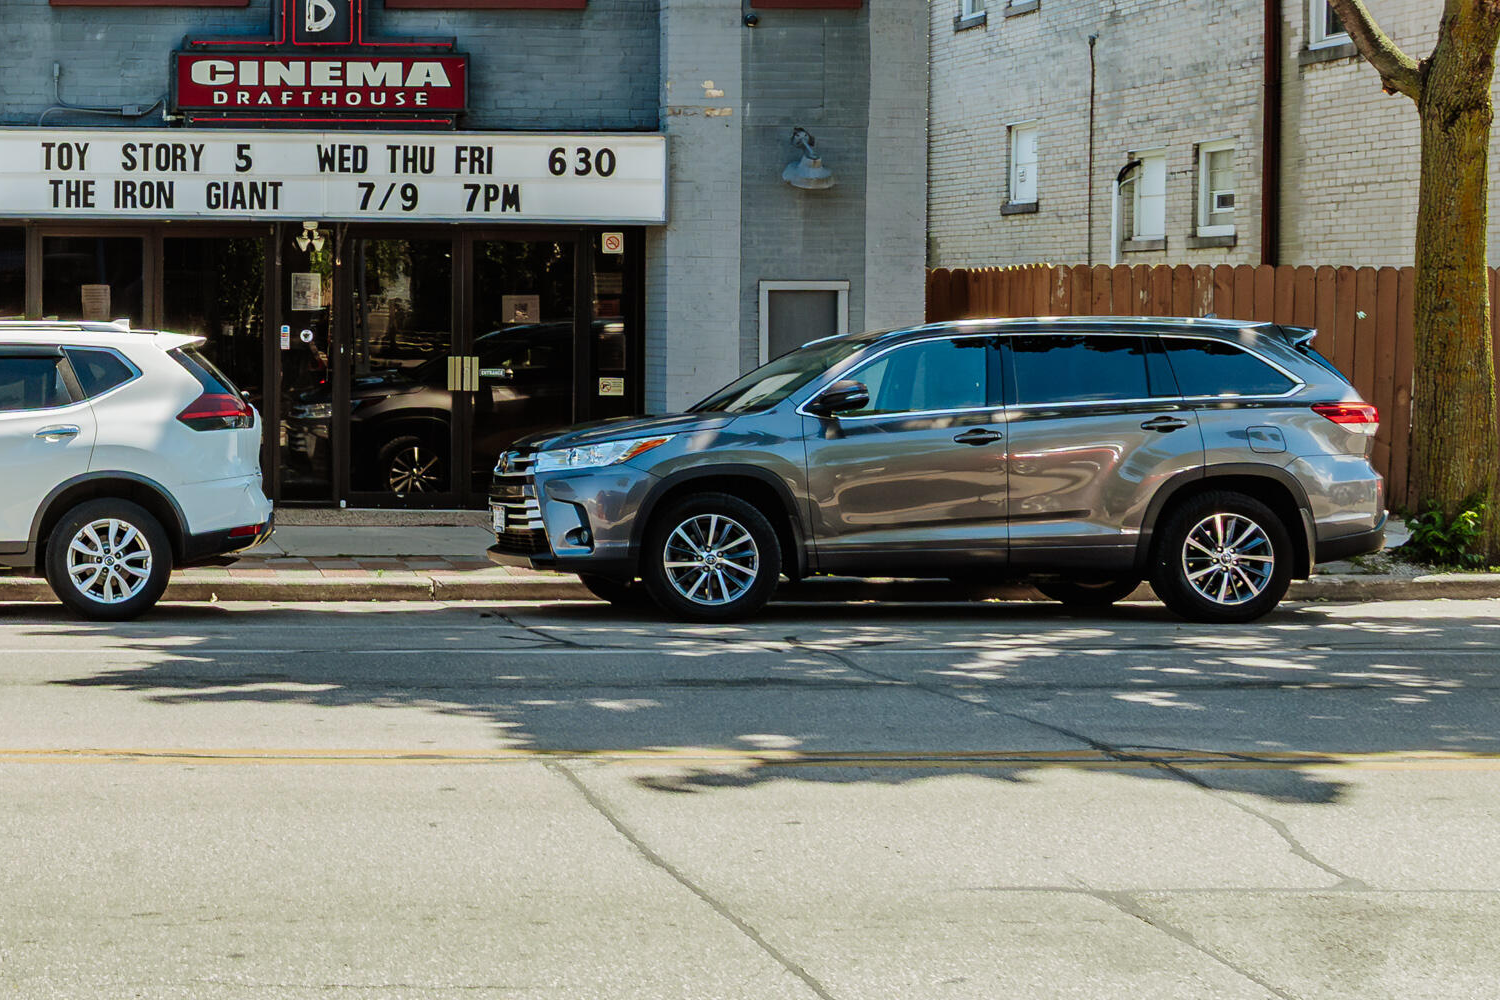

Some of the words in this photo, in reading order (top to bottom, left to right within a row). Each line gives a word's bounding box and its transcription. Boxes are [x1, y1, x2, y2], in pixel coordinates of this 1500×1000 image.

[190, 59, 452, 87] CINEMA
[213, 91, 428, 106] DRAFTHOUSE
[41, 142, 90, 172] TOY
[121, 142, 205, 173] STORY
[234, 143, 254, 174] 5
[316, 143, 369, 175] WED
[386, 144, 436, 175] THU
[454, 145, 494, 175] FRI
[49, 179, 96, 209] THE
[113, 180, 175, 209] IRON
[206, 180, 283, 210] GIANT
[357, 181, 420, 212] 7/9
[463, 183, 522, 213] 7PM
